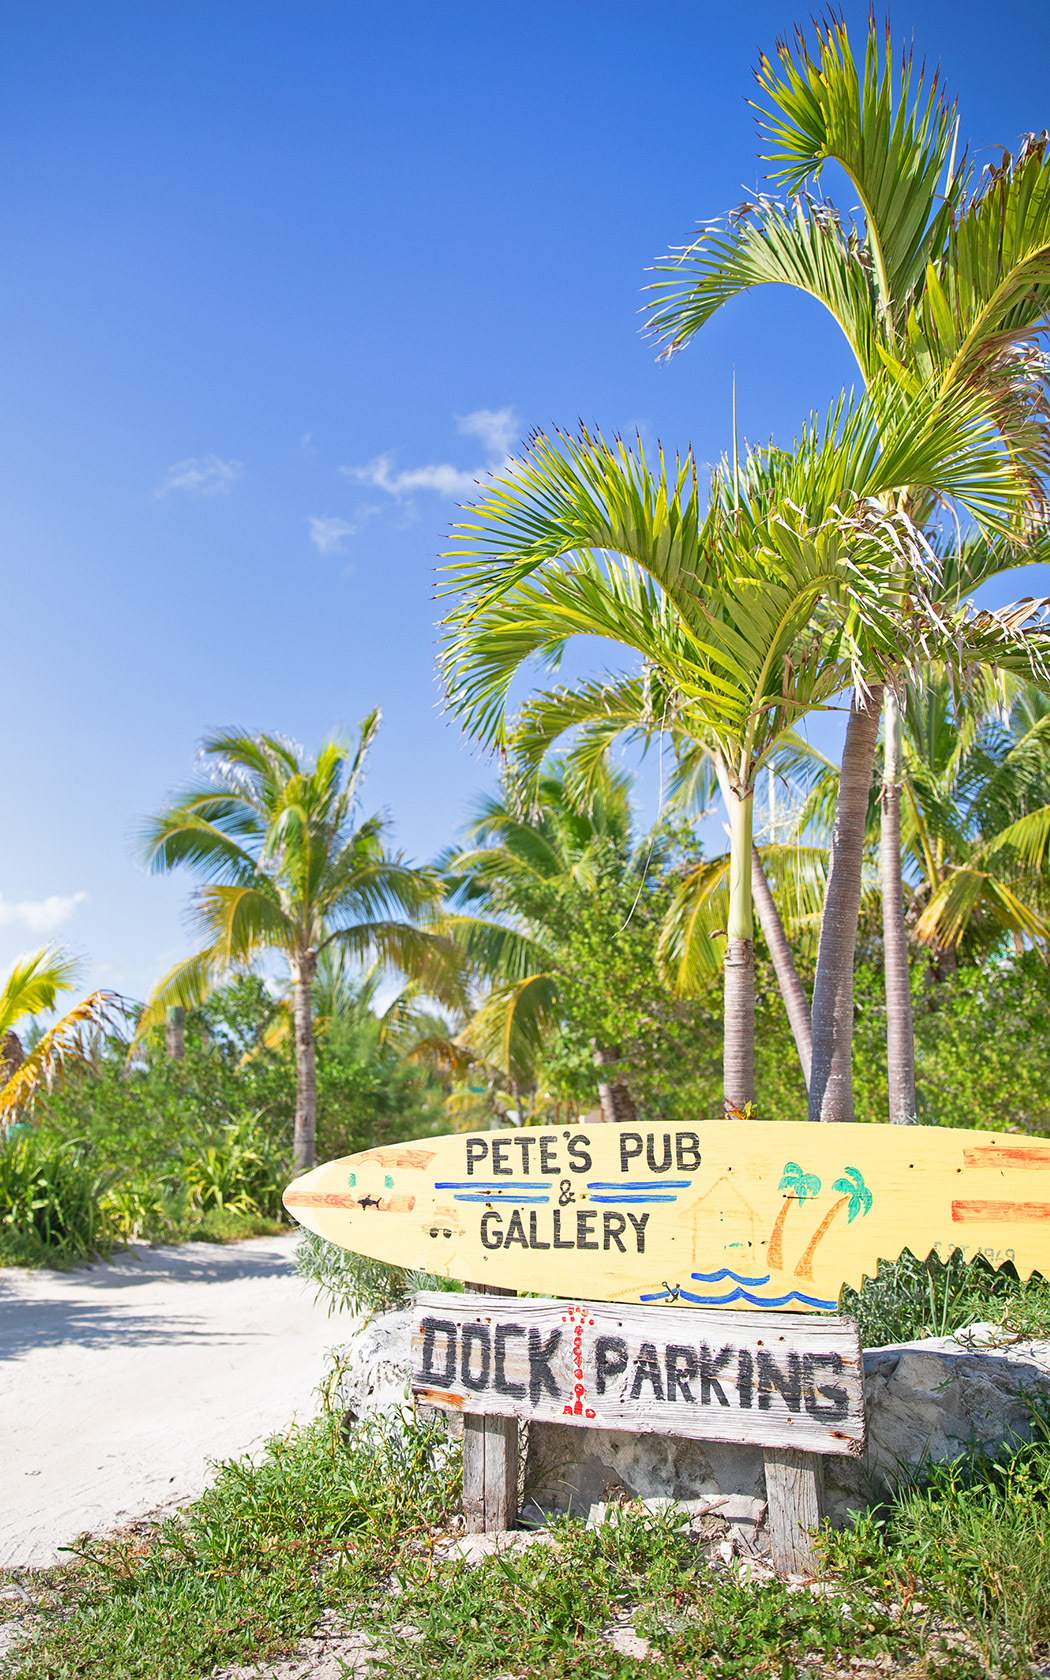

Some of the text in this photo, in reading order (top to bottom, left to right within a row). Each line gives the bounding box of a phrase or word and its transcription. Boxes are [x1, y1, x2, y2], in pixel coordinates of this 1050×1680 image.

[466, 1130, 702, 1175] PETE'S PUB
[558, 1179, 576, 1206] &
[480, 1209, 650, 1254] GALLERY
[413, 1317, 849, 1423] DOCK PARKING
